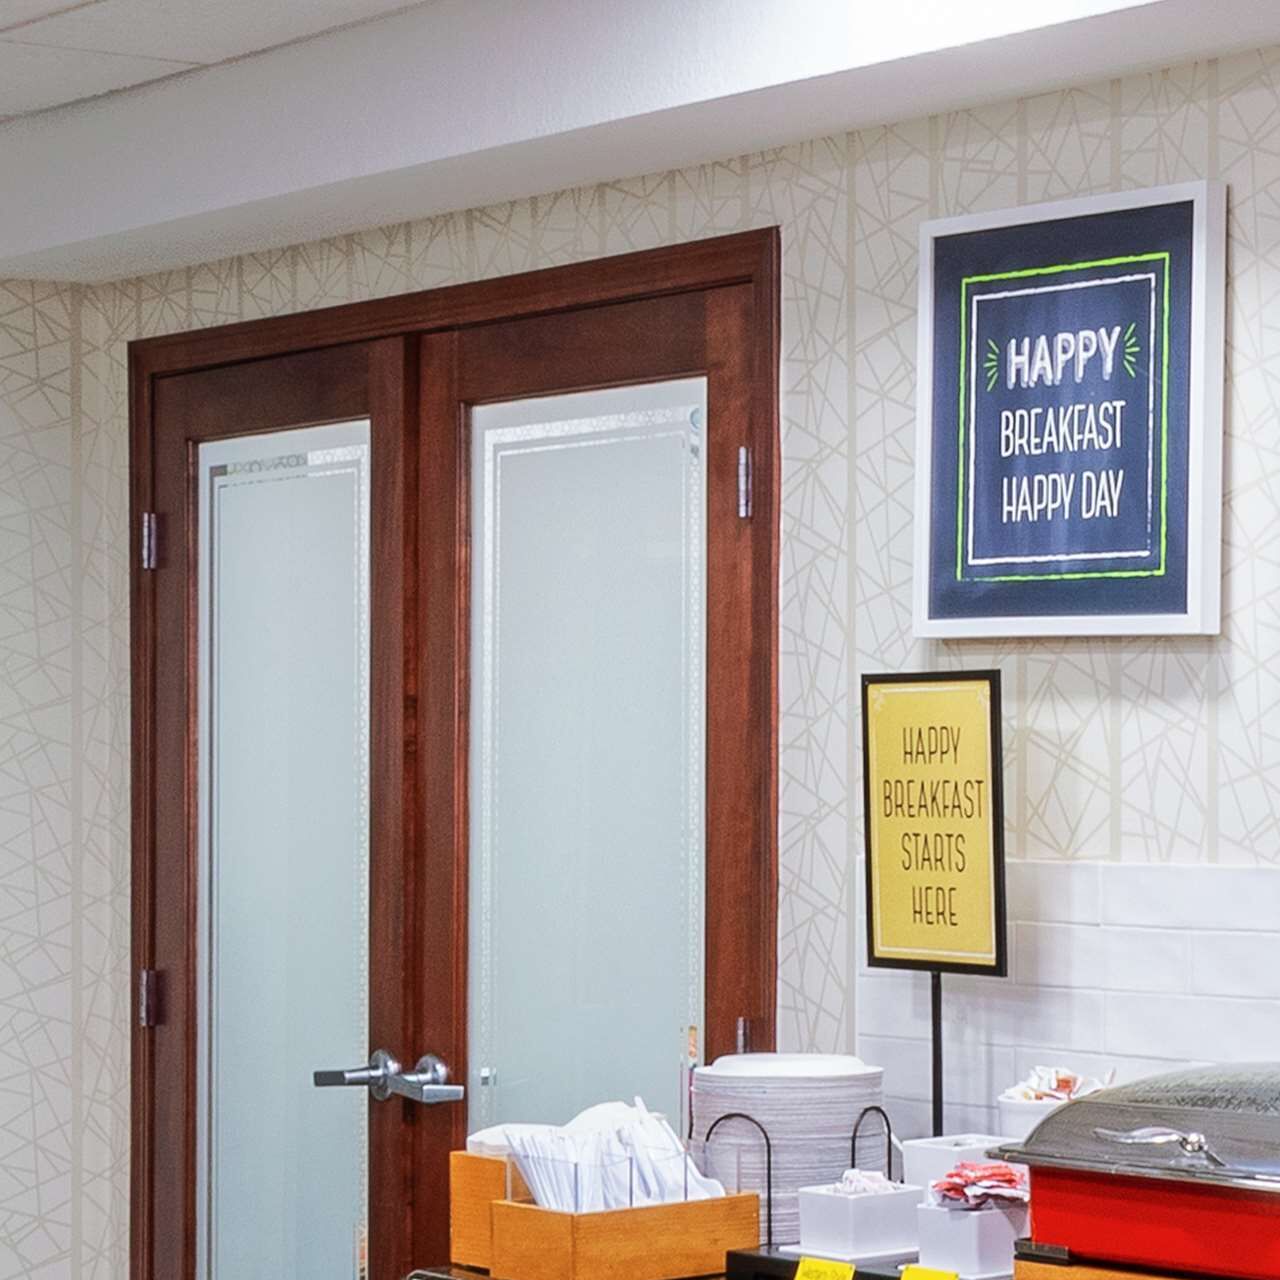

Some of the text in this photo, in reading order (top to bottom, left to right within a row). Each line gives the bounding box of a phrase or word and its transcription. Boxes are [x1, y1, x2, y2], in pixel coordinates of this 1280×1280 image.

[1009, 327, 1121, 390] HAPPY
[1002, 402, 1126, 458] BREAKFAST
[1004, 471, 1124, 523] HAPPY DAY
[903, 727, 961, 765] HAPPY
[884, 780, 984, 819] BREAKFAST
[902, 833, 966, 873] STARTS
[912, 886, 958, 926] HERE
